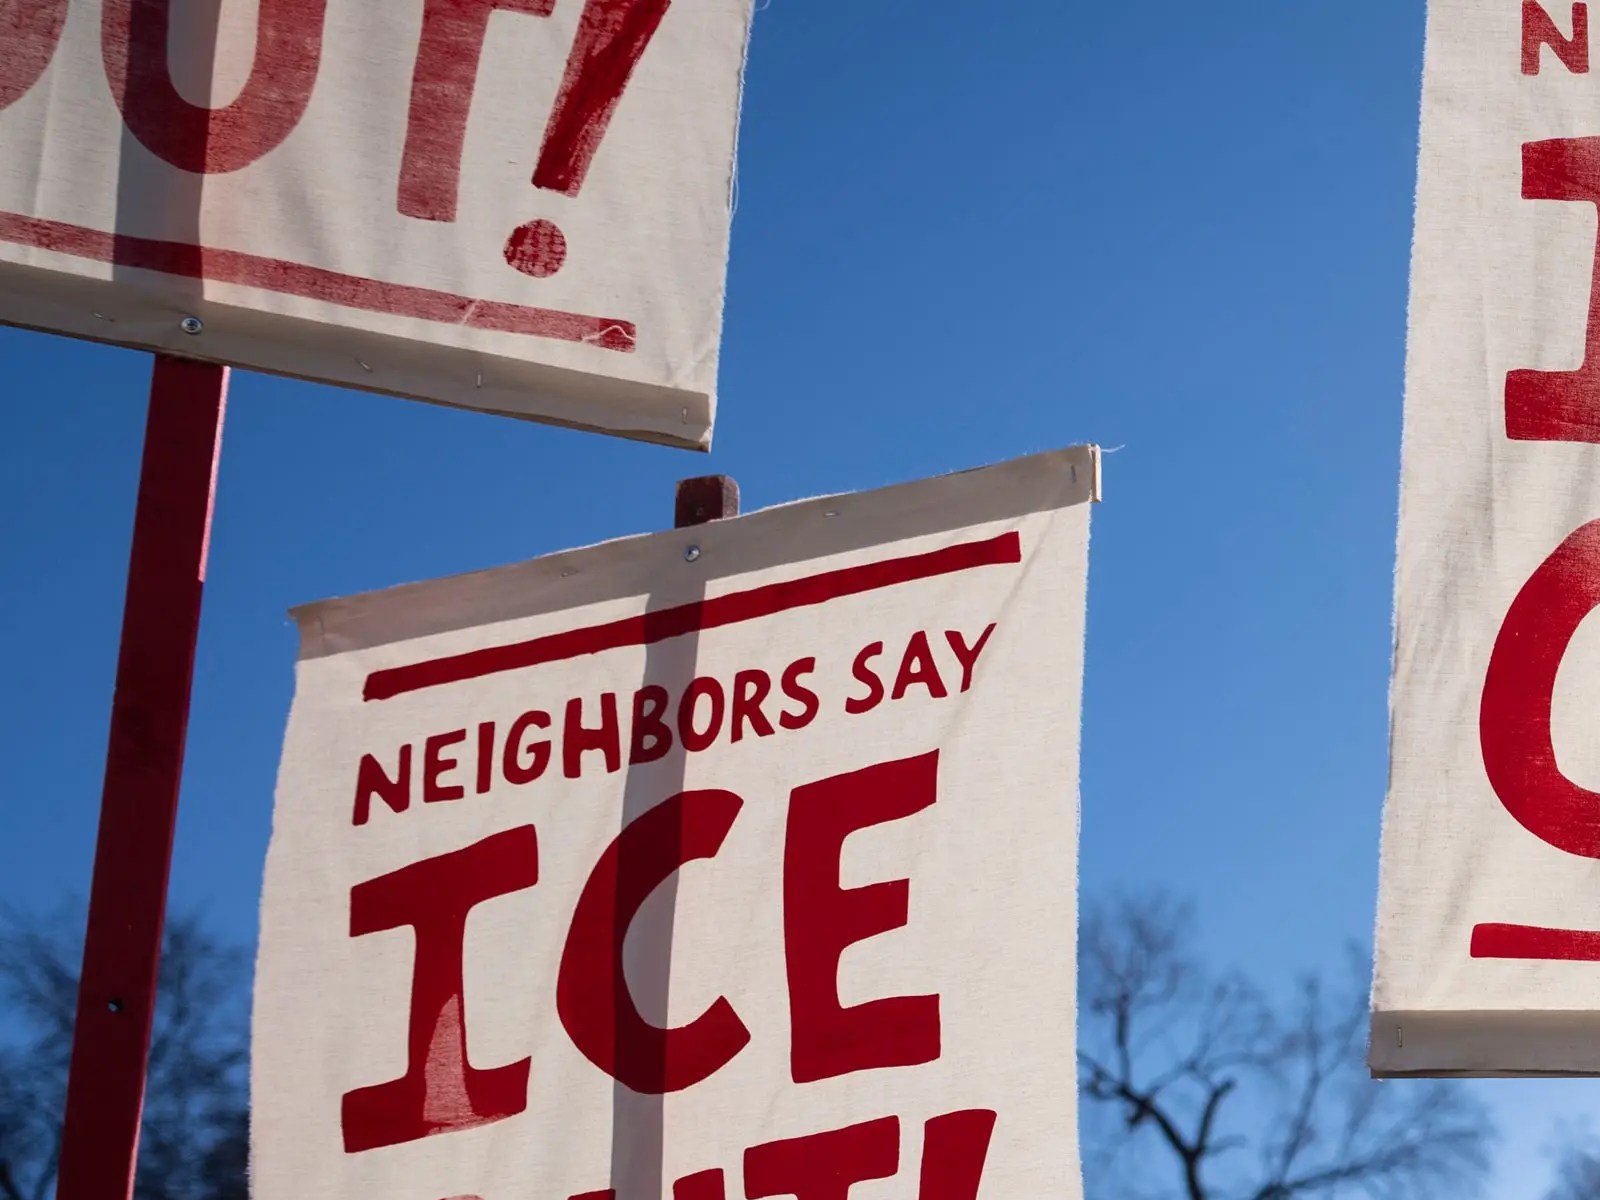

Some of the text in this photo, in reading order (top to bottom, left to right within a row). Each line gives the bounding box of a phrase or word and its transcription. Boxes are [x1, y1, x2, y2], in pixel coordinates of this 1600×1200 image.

[0, 0, 671, 277] UT!
[353, 623, 997, 826] NEIGHBORS SAY
[341, 749, 942, 1154] ICE
